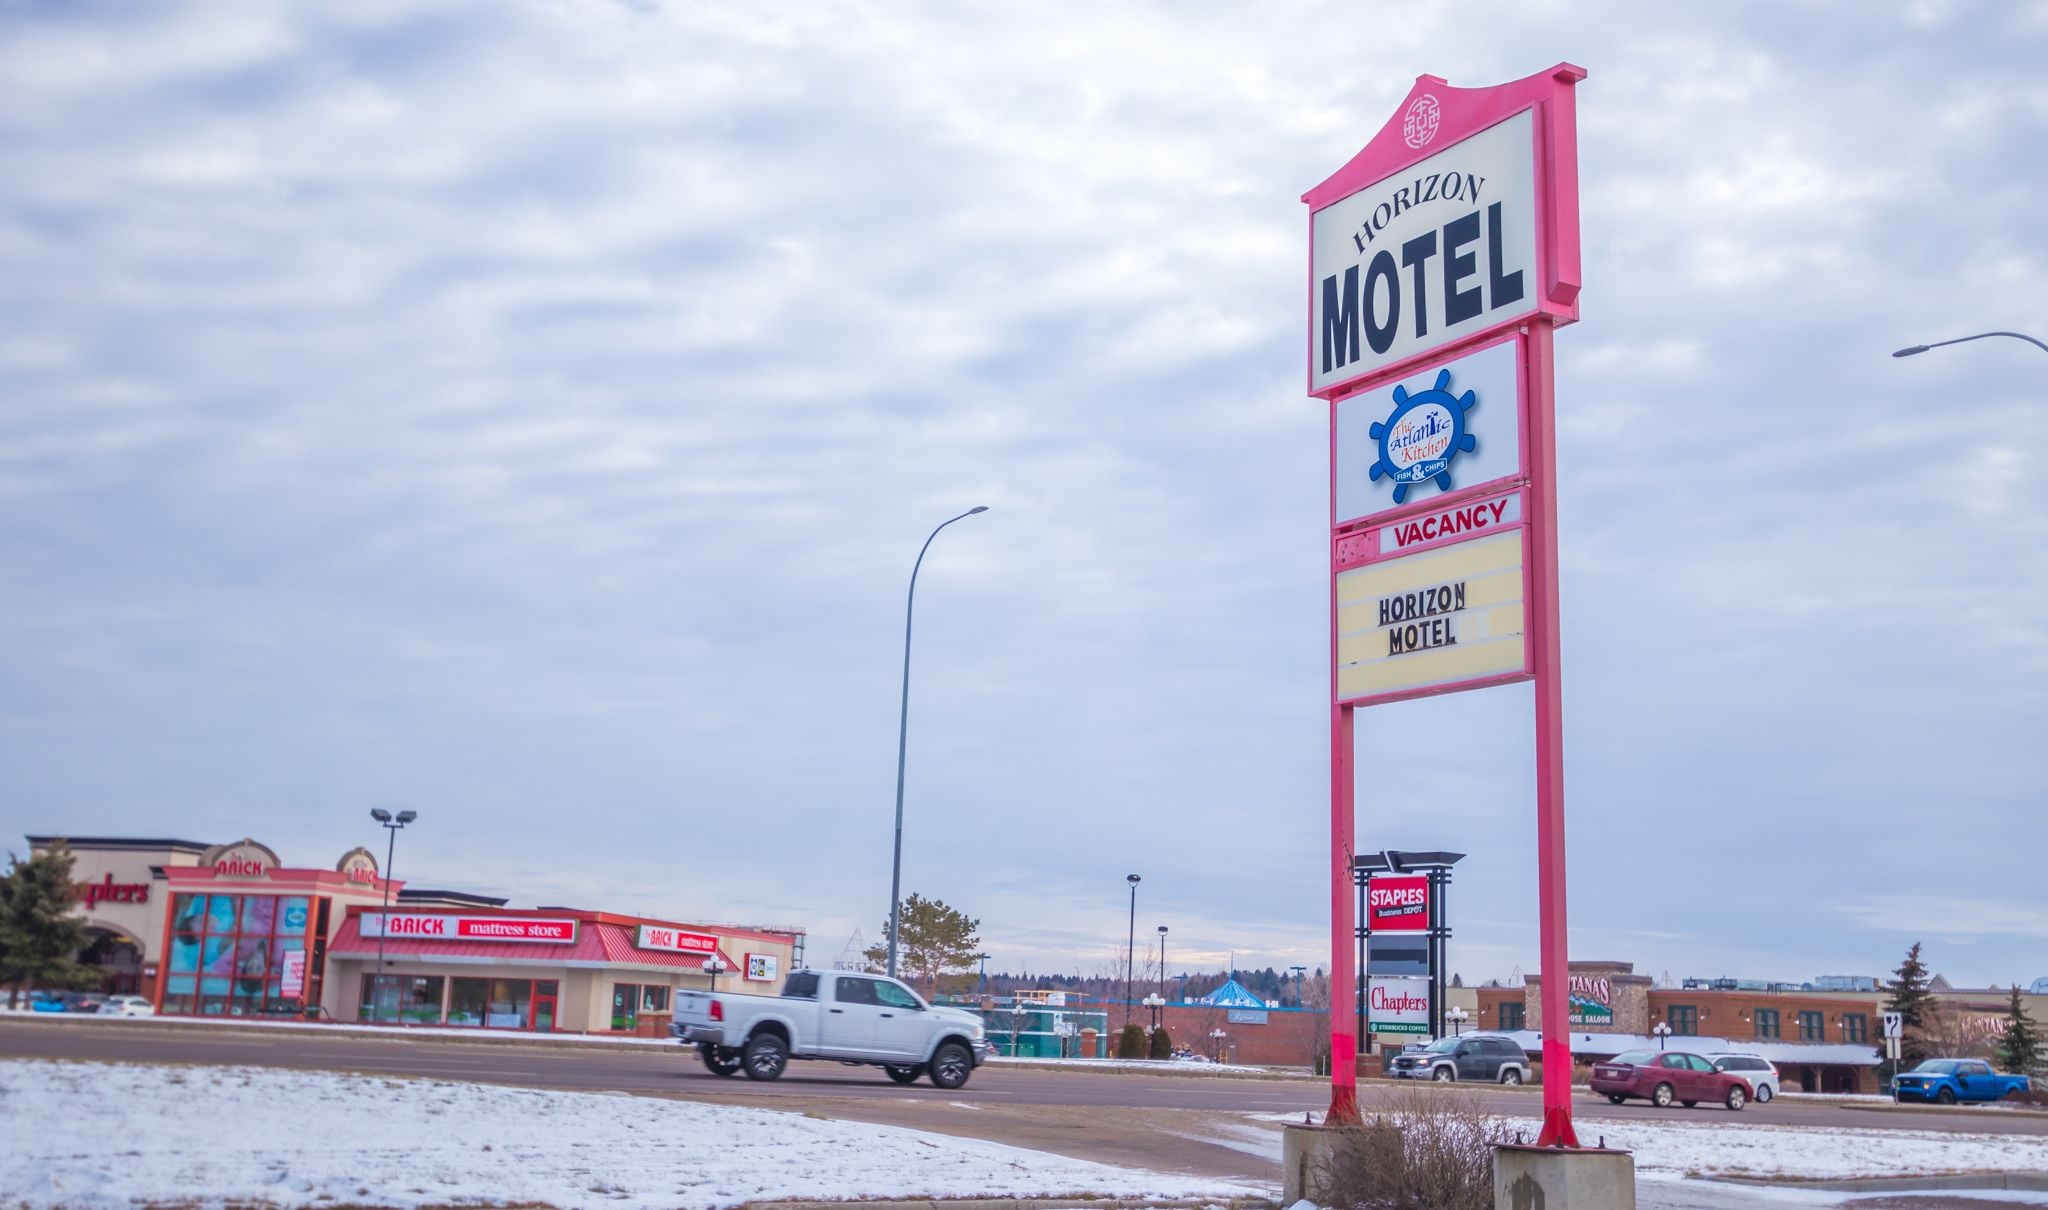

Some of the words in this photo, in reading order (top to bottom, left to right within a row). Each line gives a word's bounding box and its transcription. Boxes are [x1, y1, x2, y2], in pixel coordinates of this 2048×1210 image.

[1353, 171, 1486, 255] HORIZON
[1322, 201, 1524, 375] MOTEL
[1393, 418, 1412, 438] The
[1402, 436, 1448, 463] Kitchen
[1396, 471, 1412, 481] FISH
[1411, 463, 1425, 481] &
[1424, 460, 1445, 473] CHIPS
[1394, 499, 1508, 547] VACANCY
[1379, 582, 1466, 626] HORIZON
[1388, 617, 1457, 655] MOTEL
[216, 860, 263, 876] BRICK
[75, 872, 150, 911] pters
[1370, 888, 1425, 906] STAPLES
[1403, 905, 1423, 915] DEPOT
[390, 917, 444, 934] BRICK
[469, 923, 526, 936] mattress
[527, 924, 562, 937] store
[650, 929, 672, 946] BRICK
[1371, 986, 1427, 1015] Chapters
[1567, 976, 1609, 1005] TANA'S
[1585, 1015, 1611, 1023] SALOON
